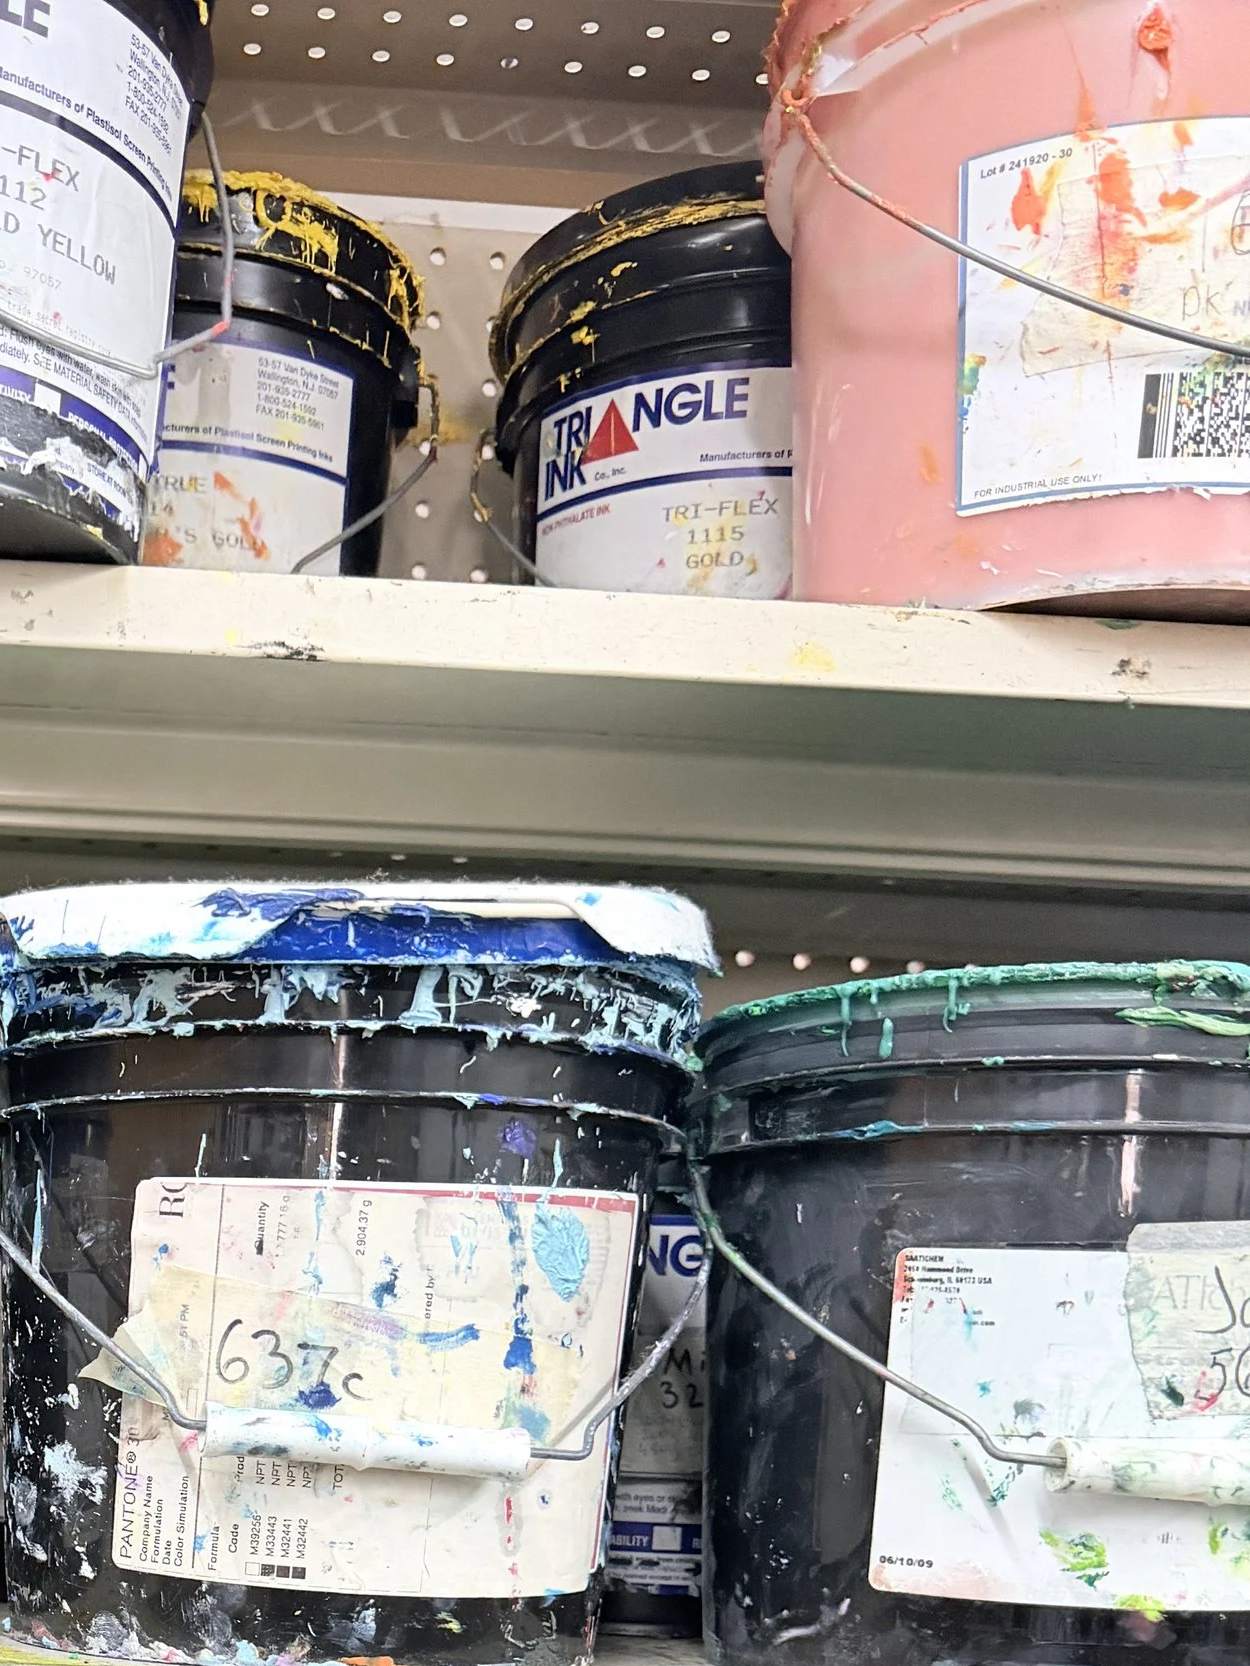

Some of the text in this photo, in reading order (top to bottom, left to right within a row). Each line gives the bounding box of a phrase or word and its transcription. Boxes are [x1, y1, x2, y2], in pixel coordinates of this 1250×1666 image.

[86, 108, 122, 141] Plastisol
[123, 135, 146, 163] Screen
[979, 147, 1073, 180] Lot 241920 30
[37, 223, 117, 285] YELLOW
[700, 449, 771, 463] Manufacturers
[544, 449, 587, 501] INK
[973, 473, 1102, 500] FOR INDUSTRIAL USE ONLY!
[662, 497, 778, 523] TRI-FLEX
[687, 525, 745, 545] 1115
[686, 551, 744, 569] GOLD
[140, 1475, 153, 1562] Company Name
[151, 1499, 163, 1564] Formulation
[174, 1475, 189, 1567] Color Simulation
[163, 1540, 172, 1565] Date
[228, 1523, 239, 1553] Code
